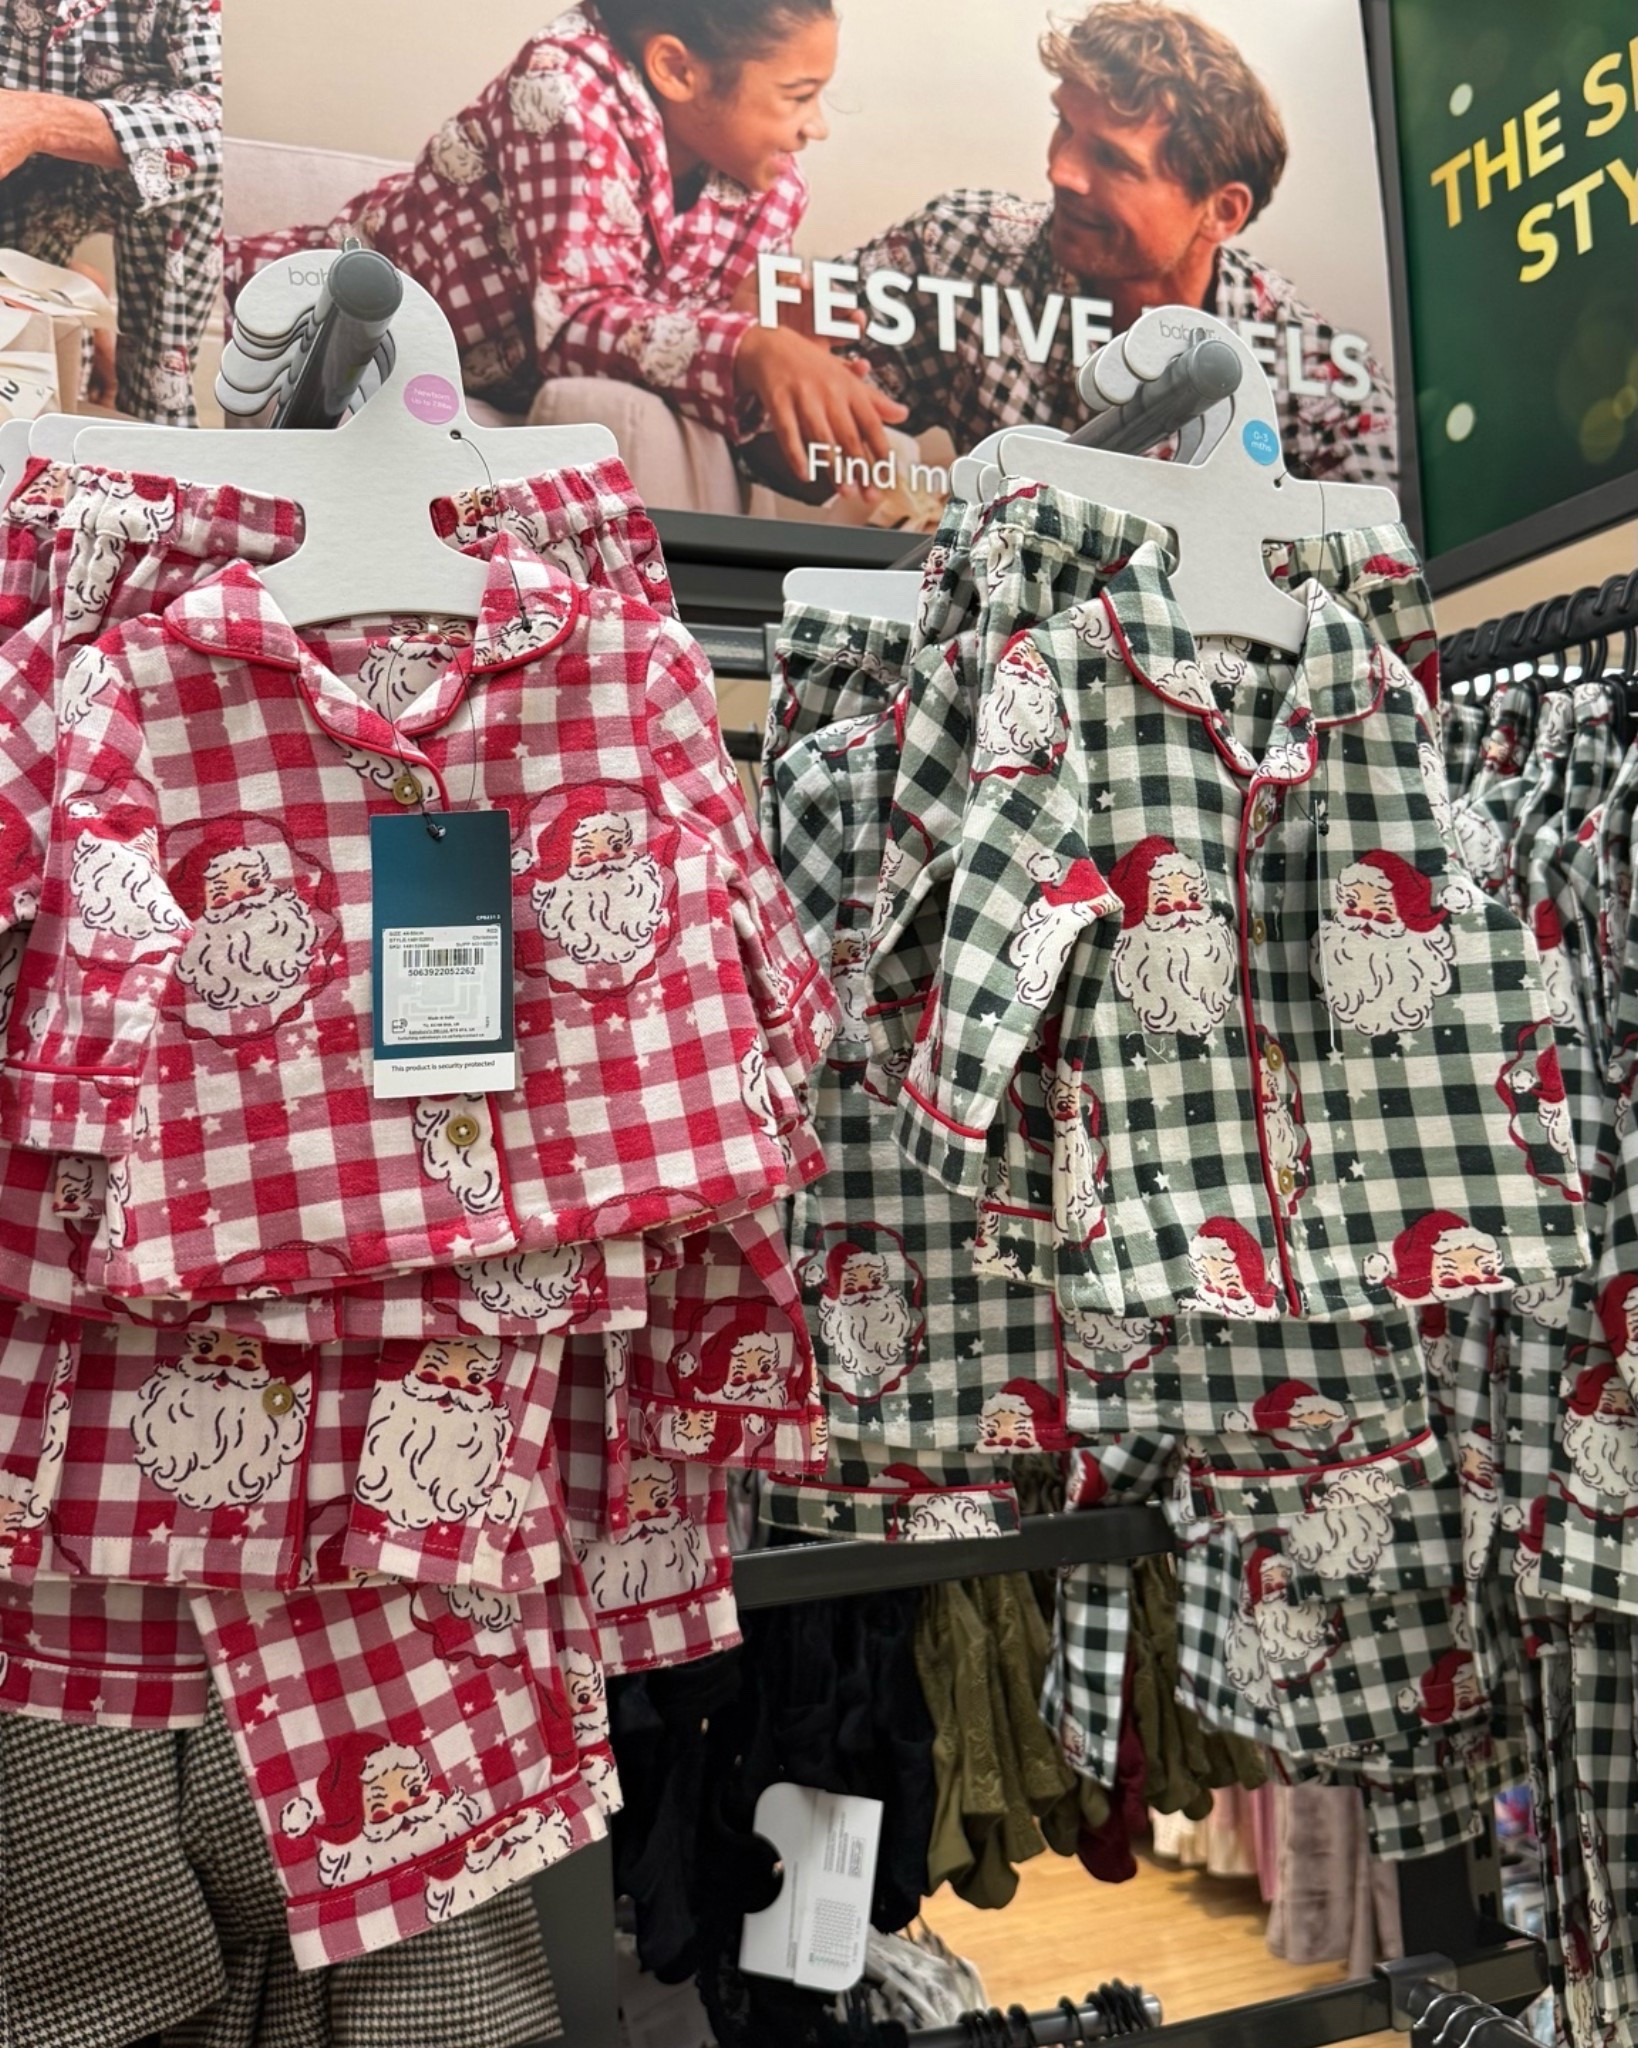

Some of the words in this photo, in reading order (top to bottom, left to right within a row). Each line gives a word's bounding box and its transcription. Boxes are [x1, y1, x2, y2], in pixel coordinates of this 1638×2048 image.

[1430, 89, 1565, 229] THE
[758, 252, 1112, 367] FESTIVE
[1254, 431, 1268, 442] 0-3
[807, 442, 896, 490] Find
[408, 968, 476, 976] 5063922052262
[464, 1060, 495, 1069] protected
